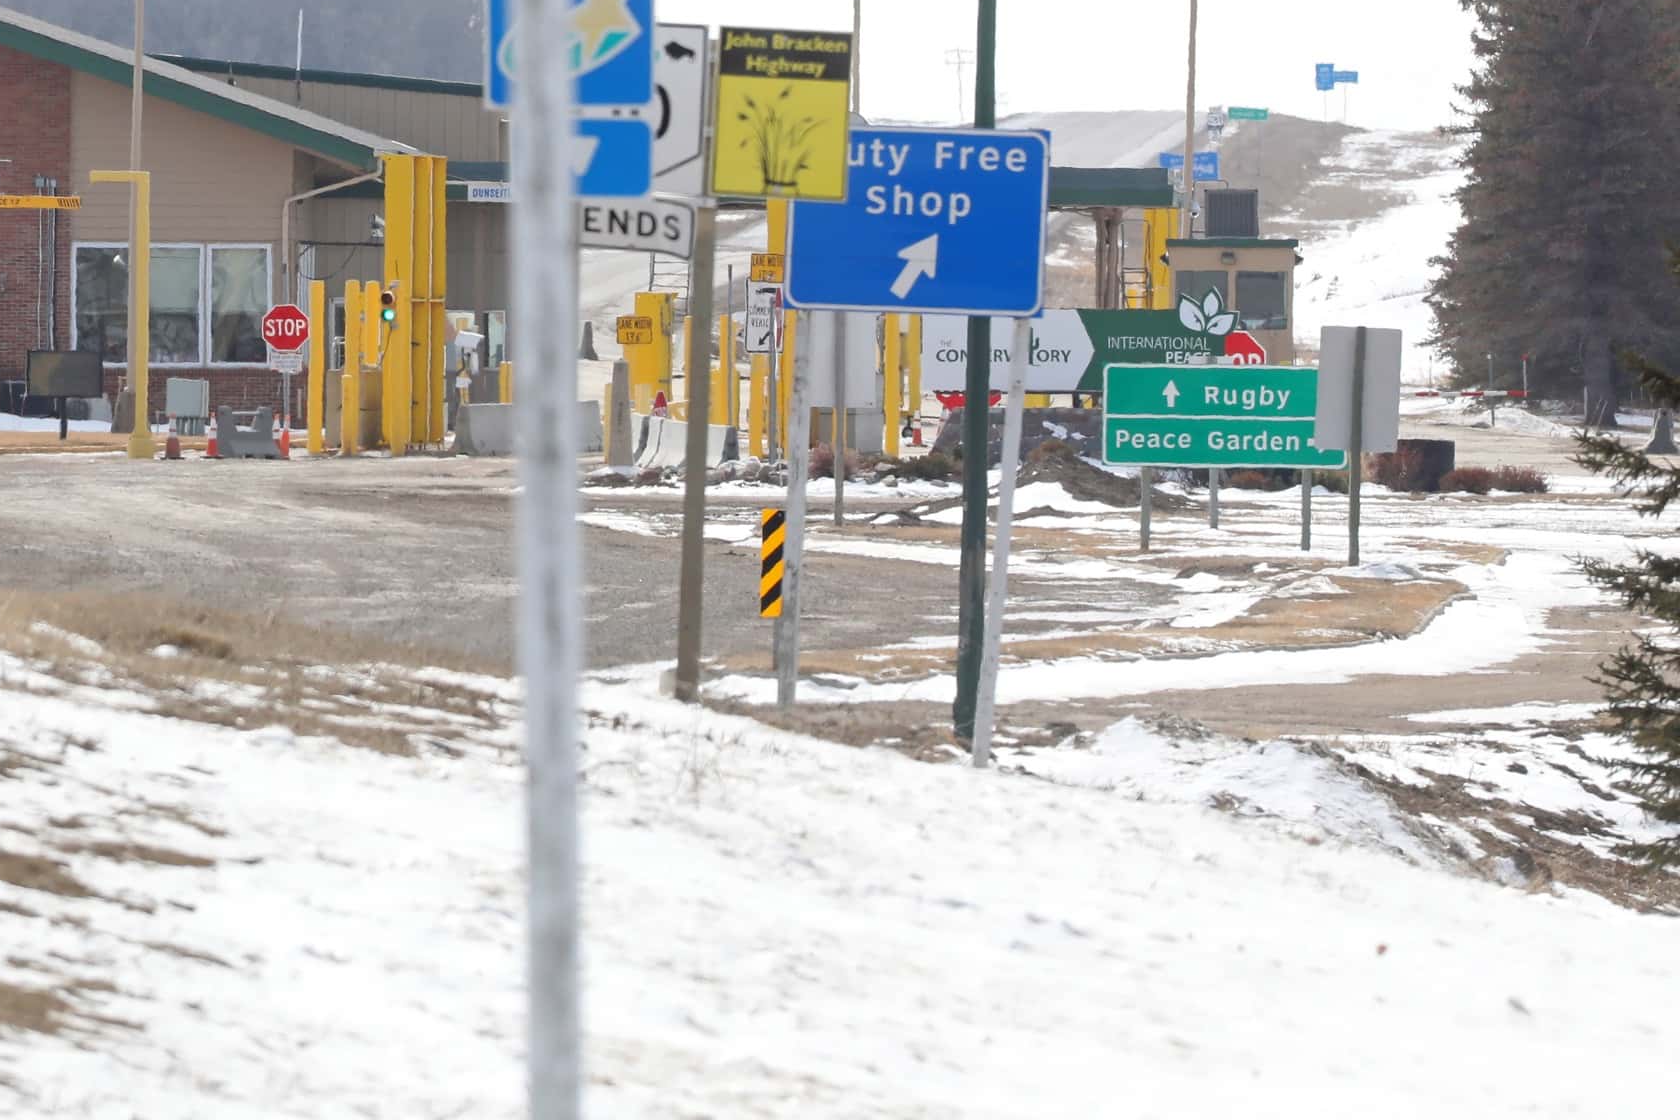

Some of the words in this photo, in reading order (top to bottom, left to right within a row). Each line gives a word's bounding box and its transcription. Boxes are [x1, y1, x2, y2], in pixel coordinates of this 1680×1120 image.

[724, 31, 768, 50] John
[772, 33, 849, 53] Bracken
[745, 54, 827, 78] Highway
[848, 138, 910, 176] uty
[934, 141, 1027, 172] Free
[865, 184, 972, 225] Shop
[584, 206, 681, 241] ENDS
[265, 318, 306, 337] STOP
[1107, 336, 1211, 350] INTERNATIONAL
[1204, 385, 1291, 410] Rugby
[1115, 430, 1192, 449] Peace
[1207, 431, 1300, 451] Garden
